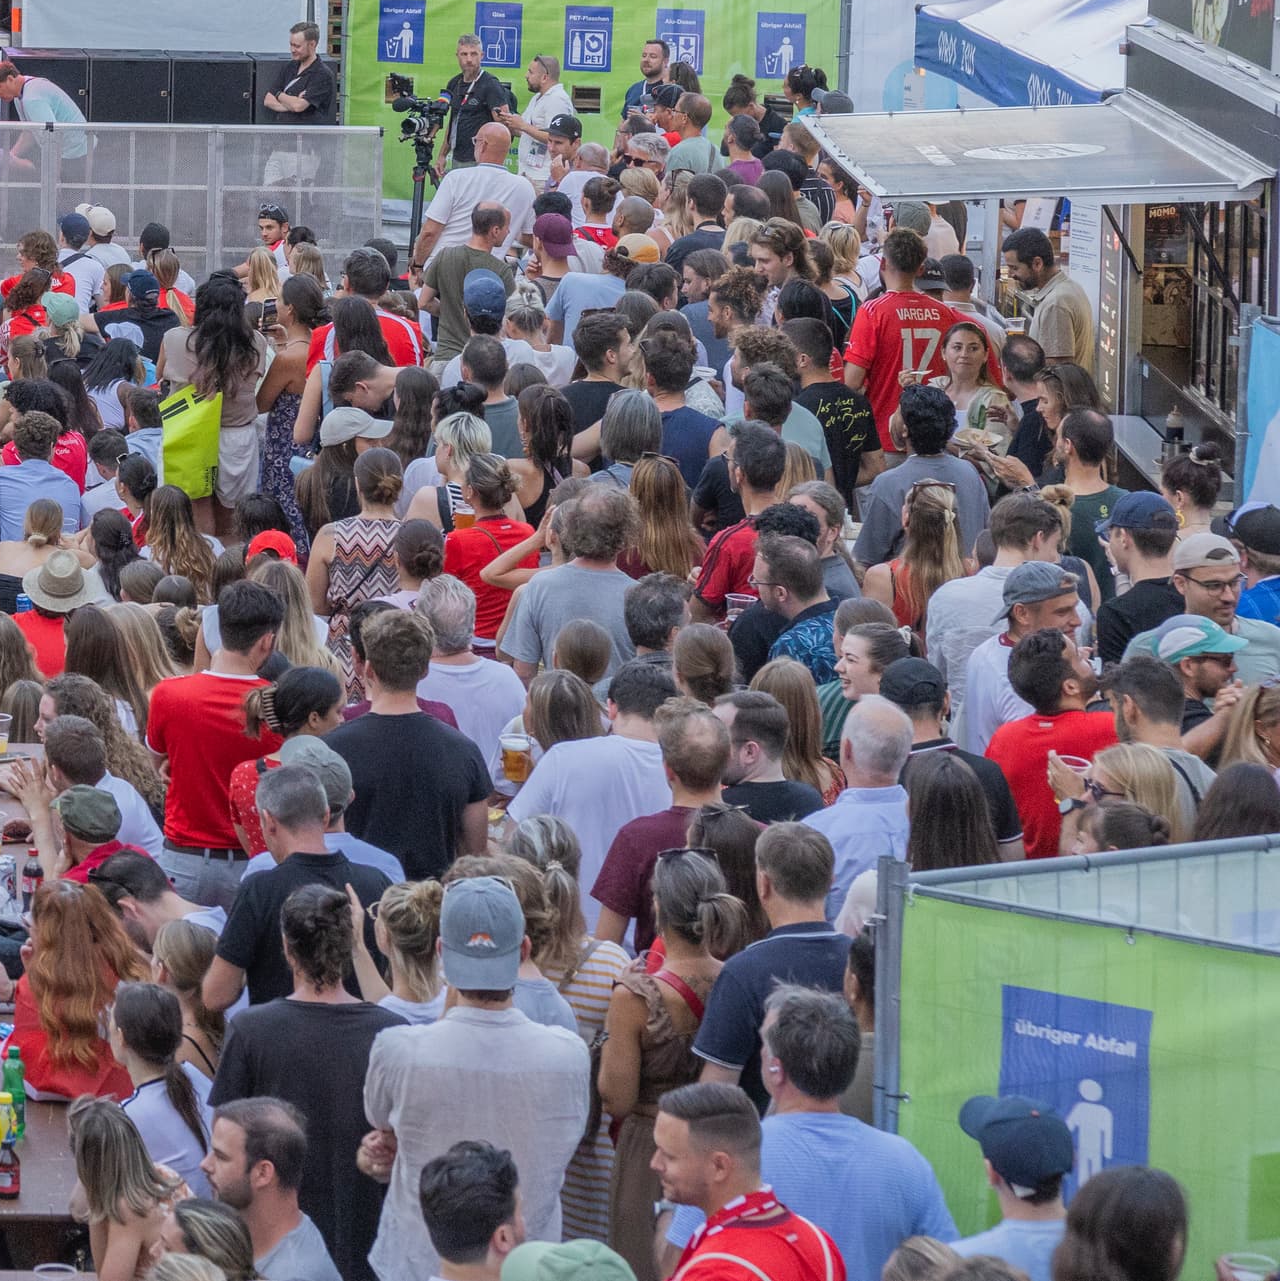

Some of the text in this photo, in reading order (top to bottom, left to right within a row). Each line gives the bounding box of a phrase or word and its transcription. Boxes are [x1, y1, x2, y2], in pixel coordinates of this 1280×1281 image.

[383, 6, 423, 15] übriger Abfall
[569, 14, 610, 23] PET-Flaschen
[760, 22, 803, 31] übriger Abfall
[585, 53, 602, 64] PET
[1148, 206, 1176, 218] MOMO
[896, 308, 941, 321] VARGAS
[900, 328, 942, 384] 17
[1014, 1019, 1138, 1058] übriger Abfall
